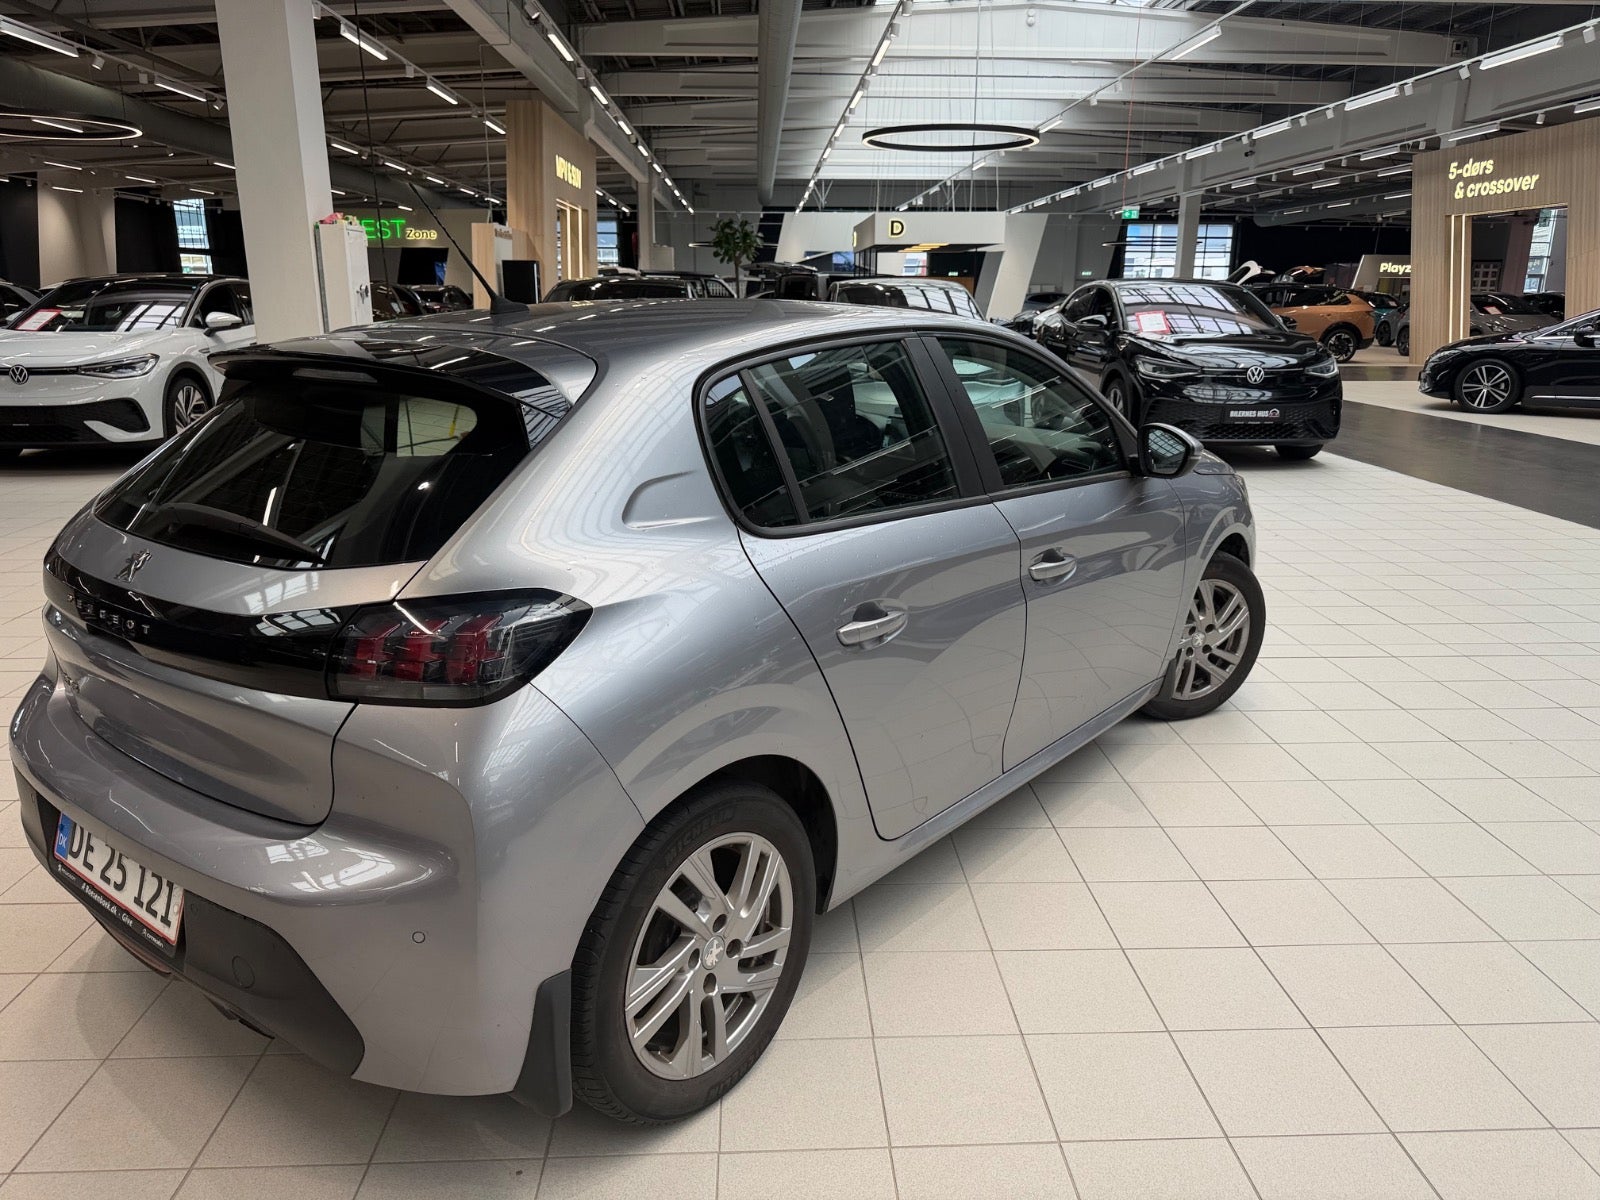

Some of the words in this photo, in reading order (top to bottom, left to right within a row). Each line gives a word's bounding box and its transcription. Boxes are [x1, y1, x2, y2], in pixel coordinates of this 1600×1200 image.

[1448, 158, 1494, 180] 5-dørs
[1454, 181, 1465, 200] &
[1466, 174, 1540, 198] crossover
[358, 218, 406, 239] EST
[405, 228, 437, 240] Zone
[890, 219, 905, 237] D
[68, 821, 94, 872] DE
[99, 843, 127, 891] 25
[133, 864, 175, 928] 121
